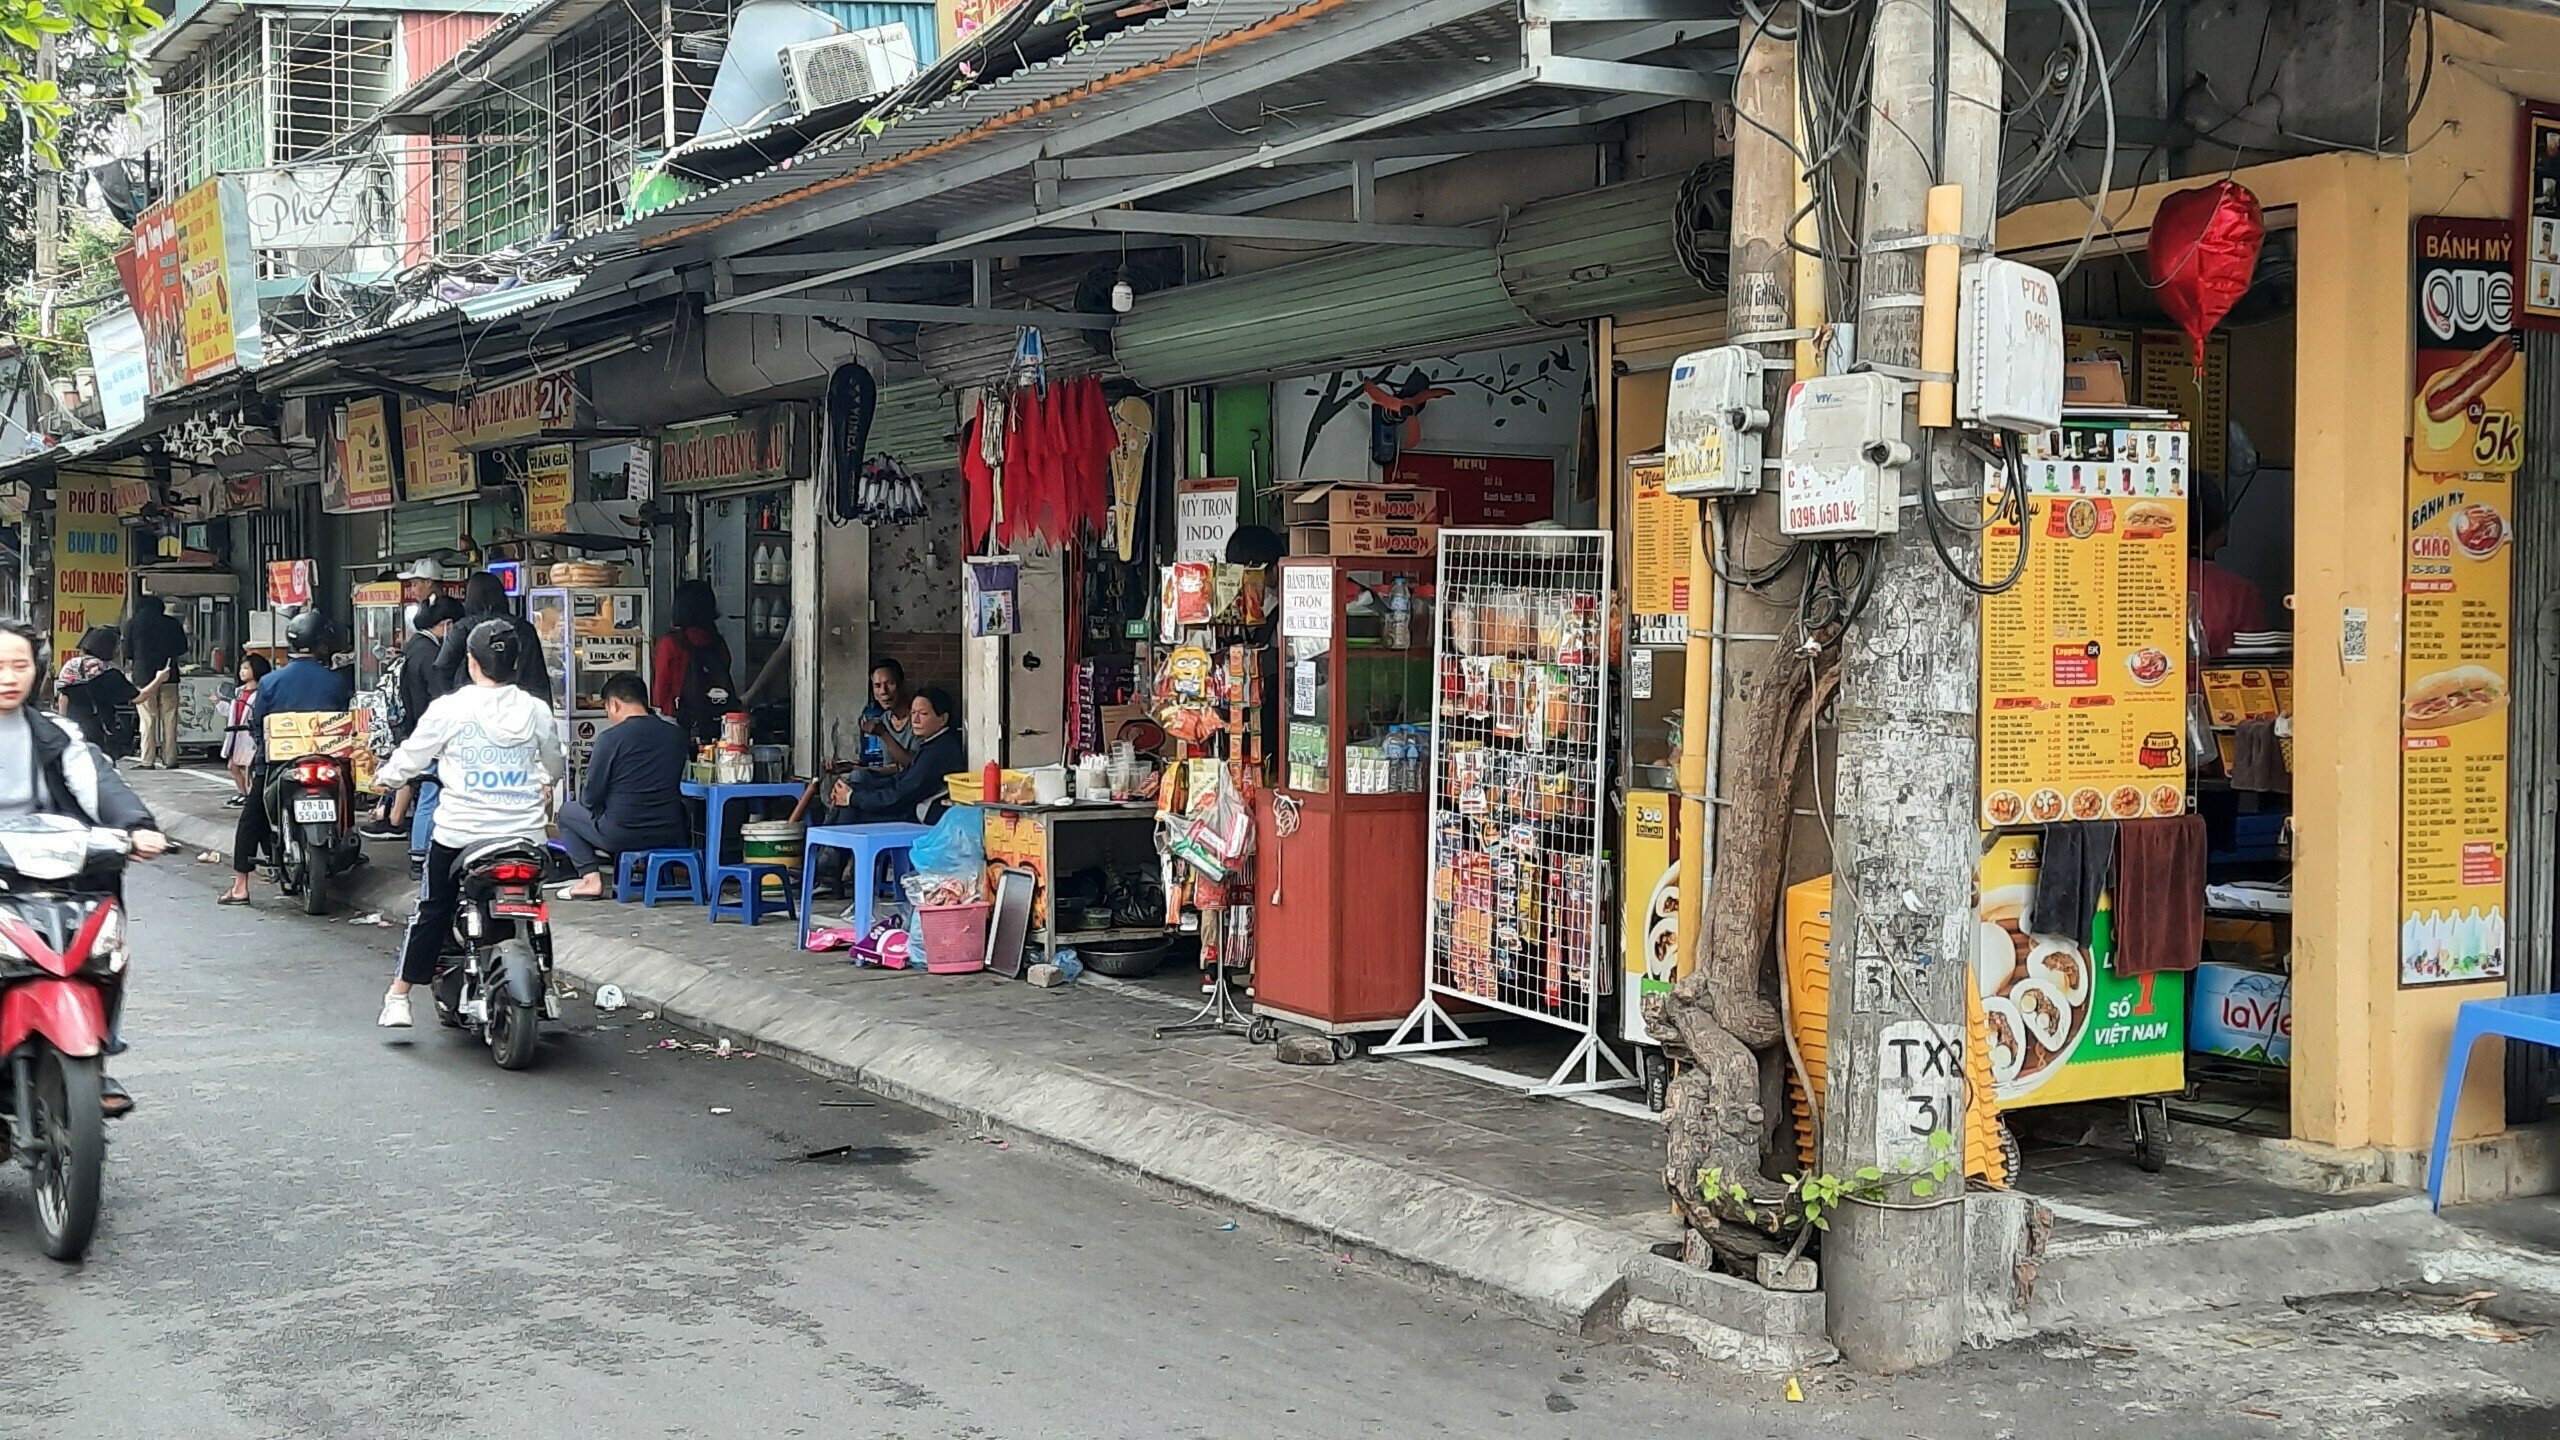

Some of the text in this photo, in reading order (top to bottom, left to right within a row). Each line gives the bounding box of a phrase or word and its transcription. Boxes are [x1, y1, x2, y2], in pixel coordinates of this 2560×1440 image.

[2426, 230, 2480, 259] BÁNH
[1185, 525, 1224, 541] INDO
[91, 571, 124, 595] RANG
[2108, 992, 2134, 1019] SỐ
[2094, 1022, 2169, 1048] VIỆT NAM
